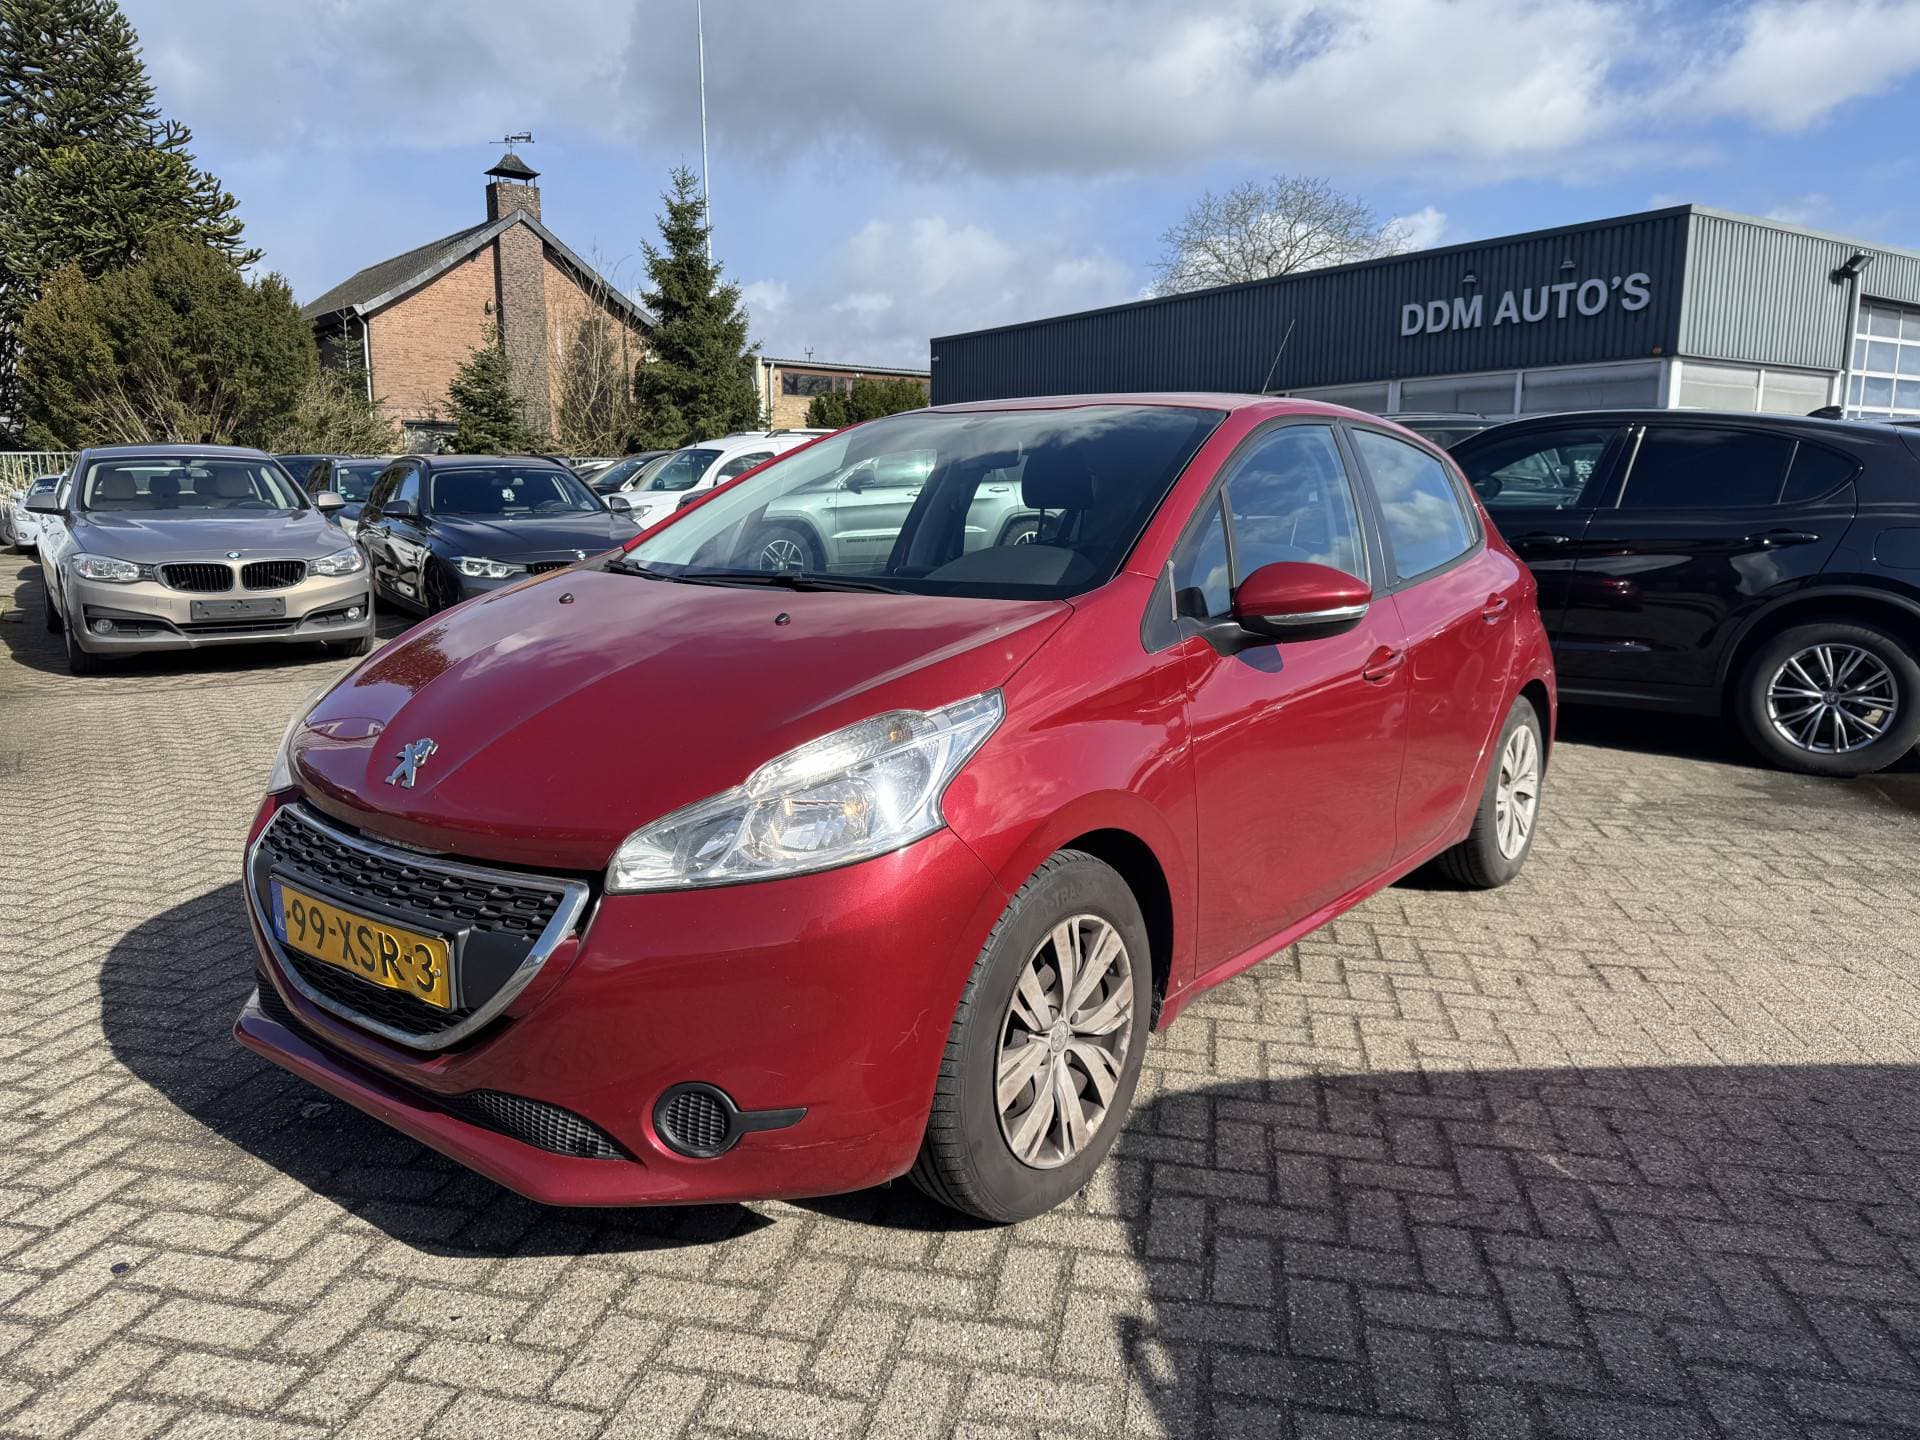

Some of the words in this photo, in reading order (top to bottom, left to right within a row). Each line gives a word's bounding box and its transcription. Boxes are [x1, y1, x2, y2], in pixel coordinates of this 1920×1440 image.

[1401, 295, 1483, 337] DDM
[1493, 272, 1651, 326] AUTO'S
[291, 899, 435, 993] 99-XSR-3
